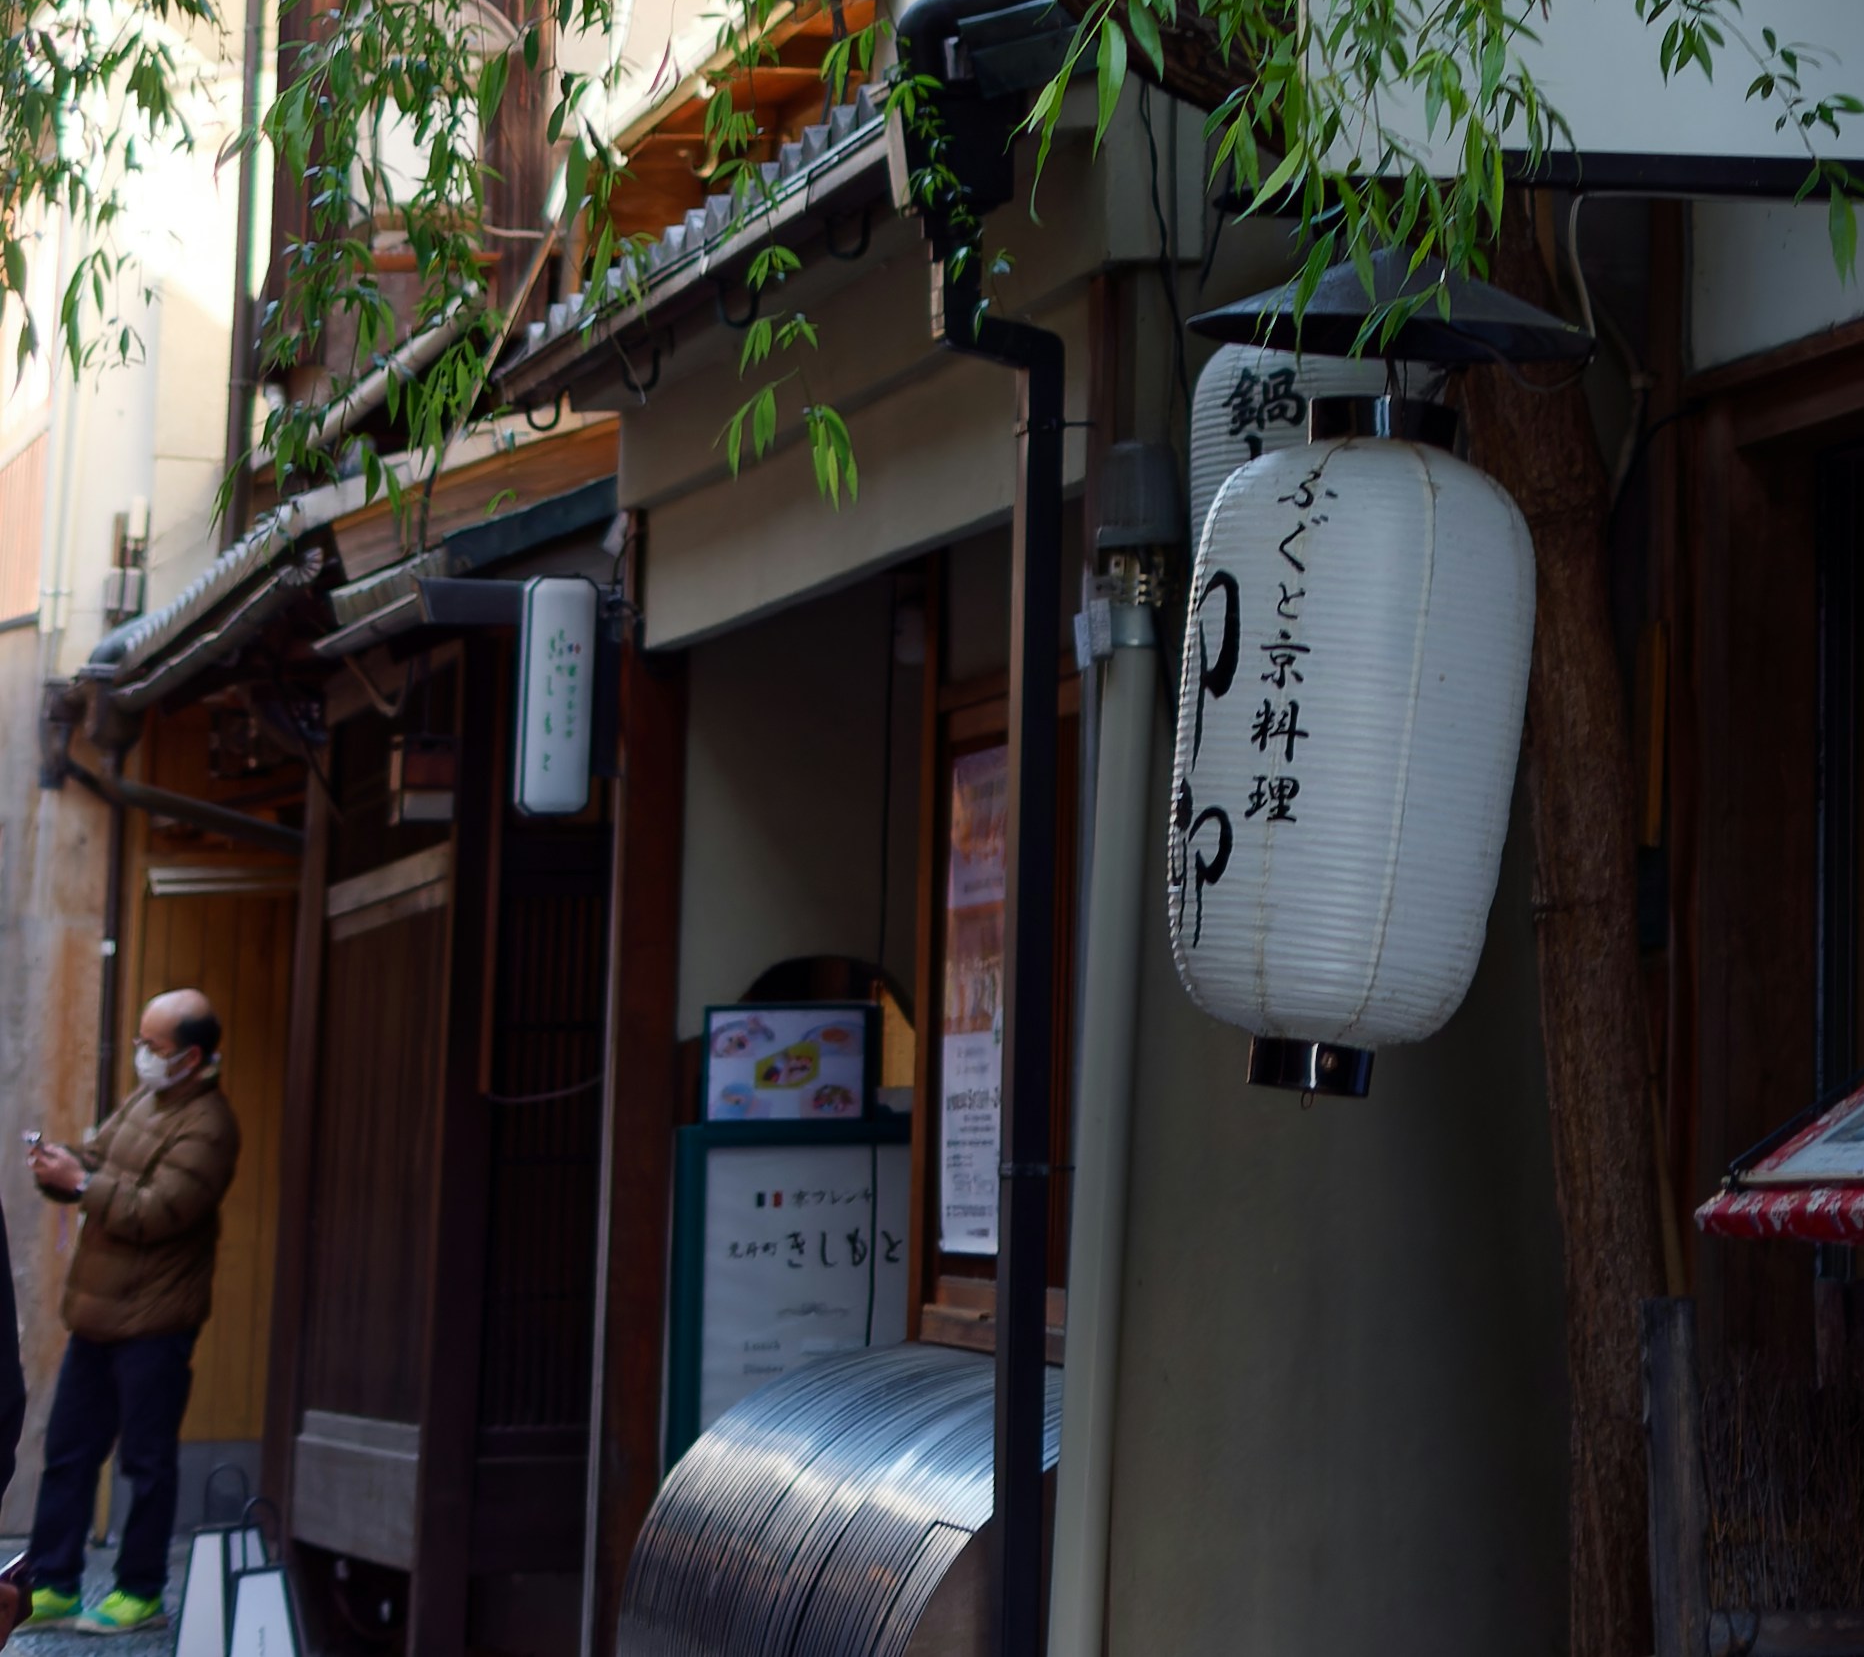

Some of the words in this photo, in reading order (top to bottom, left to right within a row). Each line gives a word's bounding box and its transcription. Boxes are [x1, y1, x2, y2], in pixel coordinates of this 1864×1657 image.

[1221, 367, 1307, 461] 鍋
[1244, 469, 1339, 824] ふぐと京料理
